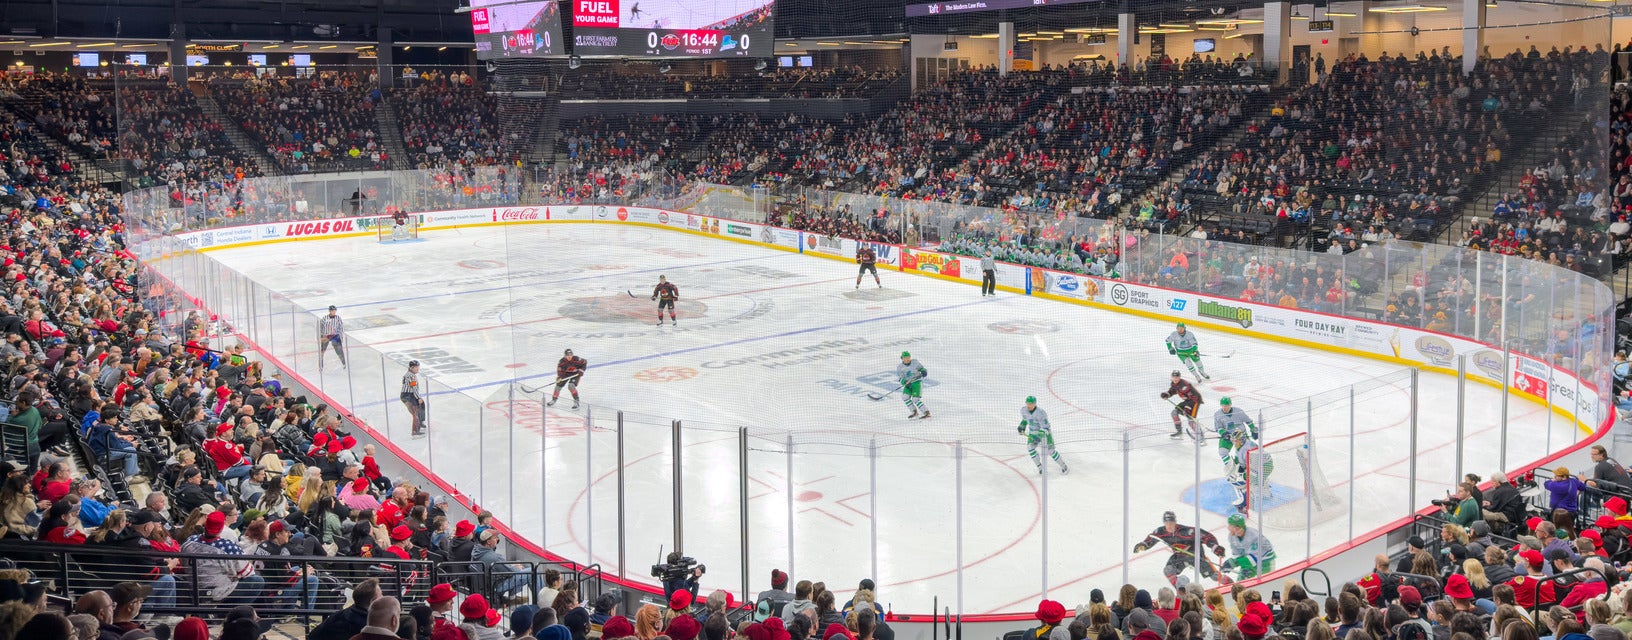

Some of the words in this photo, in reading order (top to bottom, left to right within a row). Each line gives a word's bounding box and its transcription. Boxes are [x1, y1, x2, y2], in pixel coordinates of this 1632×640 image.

[580, 0, 613, 14] FUEL
[928, 4, 939, 14] Taft
[474, 10, 486, 22] FUEL
[502, 34, 508, 50] 0
[516, 32, 534, 46] 16:44
[544, 31, 551, 48] 0
[647, 32, 658, 48] 0
[682, 33, 717, 46] 16:44
[740, 34, 750, 50] 0
[286, 221, 331, 237] LUCAS
[332, 220, 353, 232] OIL
[915, 252, 927, 263] RED
[928, 254, 944, 265] GOLD
[1114, 289, 1126, 300] SG
[1130, 290, 1148, 298] SPORT
[1130, 298, 1159, 307] GRAPHICS
[1295, 319, 1314, 329] FOUR
[1315, 322, 1329, 331] DAY
[1330, 325, 1345, 334] RAY
[700, 337, 869, 369] Community
